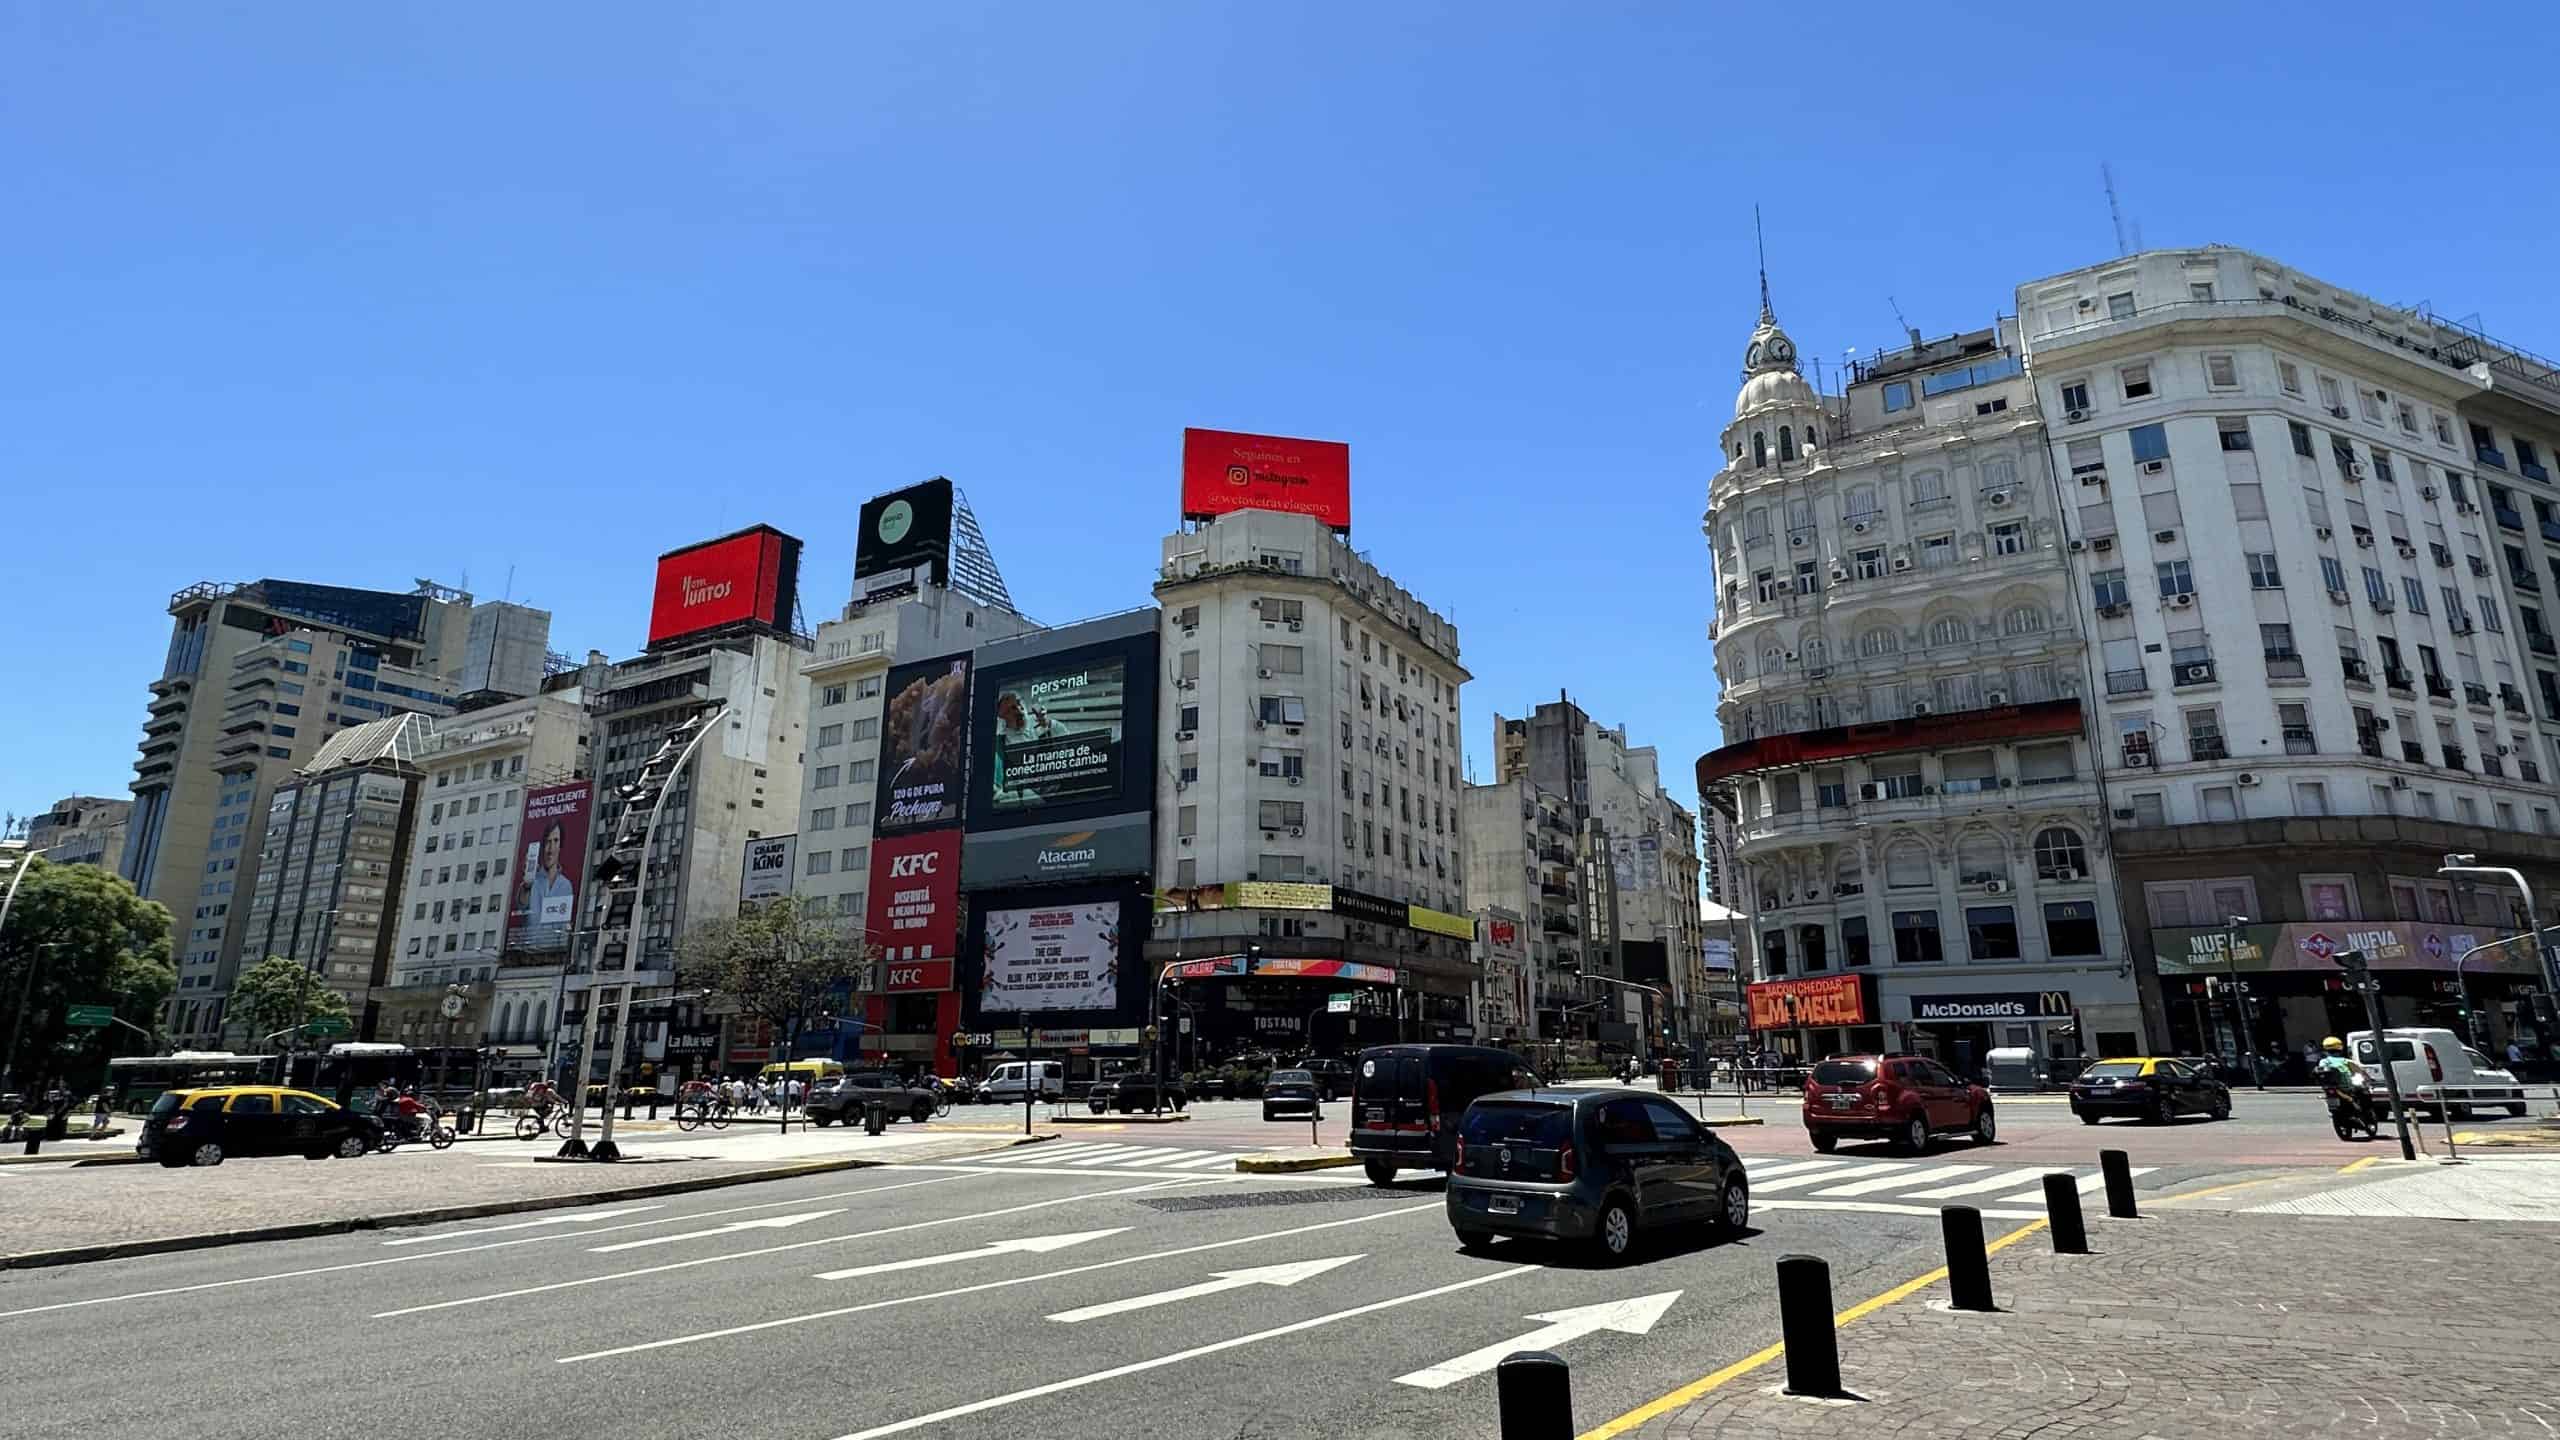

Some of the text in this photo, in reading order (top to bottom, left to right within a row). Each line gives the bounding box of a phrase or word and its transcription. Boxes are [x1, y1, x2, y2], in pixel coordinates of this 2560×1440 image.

[1031, 671, 1088, 698] personal
[1023, 744, 1090, 765] La manera de
[1069, 751, 1108, 768] cambia
[557, 789, 588, 802] CLIENTE
[1037, 848, 1096, 864] Atacama
[888, 851, 939, 879] KFC
[2346, 930, 2398, 952] NUEVA
[889, 968, 923, 985] KFC
[1797, 979, 1843, 995] CHEDDAR
[1921, 1001, 2026, 1018] McDonald's
[1254, 1016, 1301, 1031] TOSTADO
